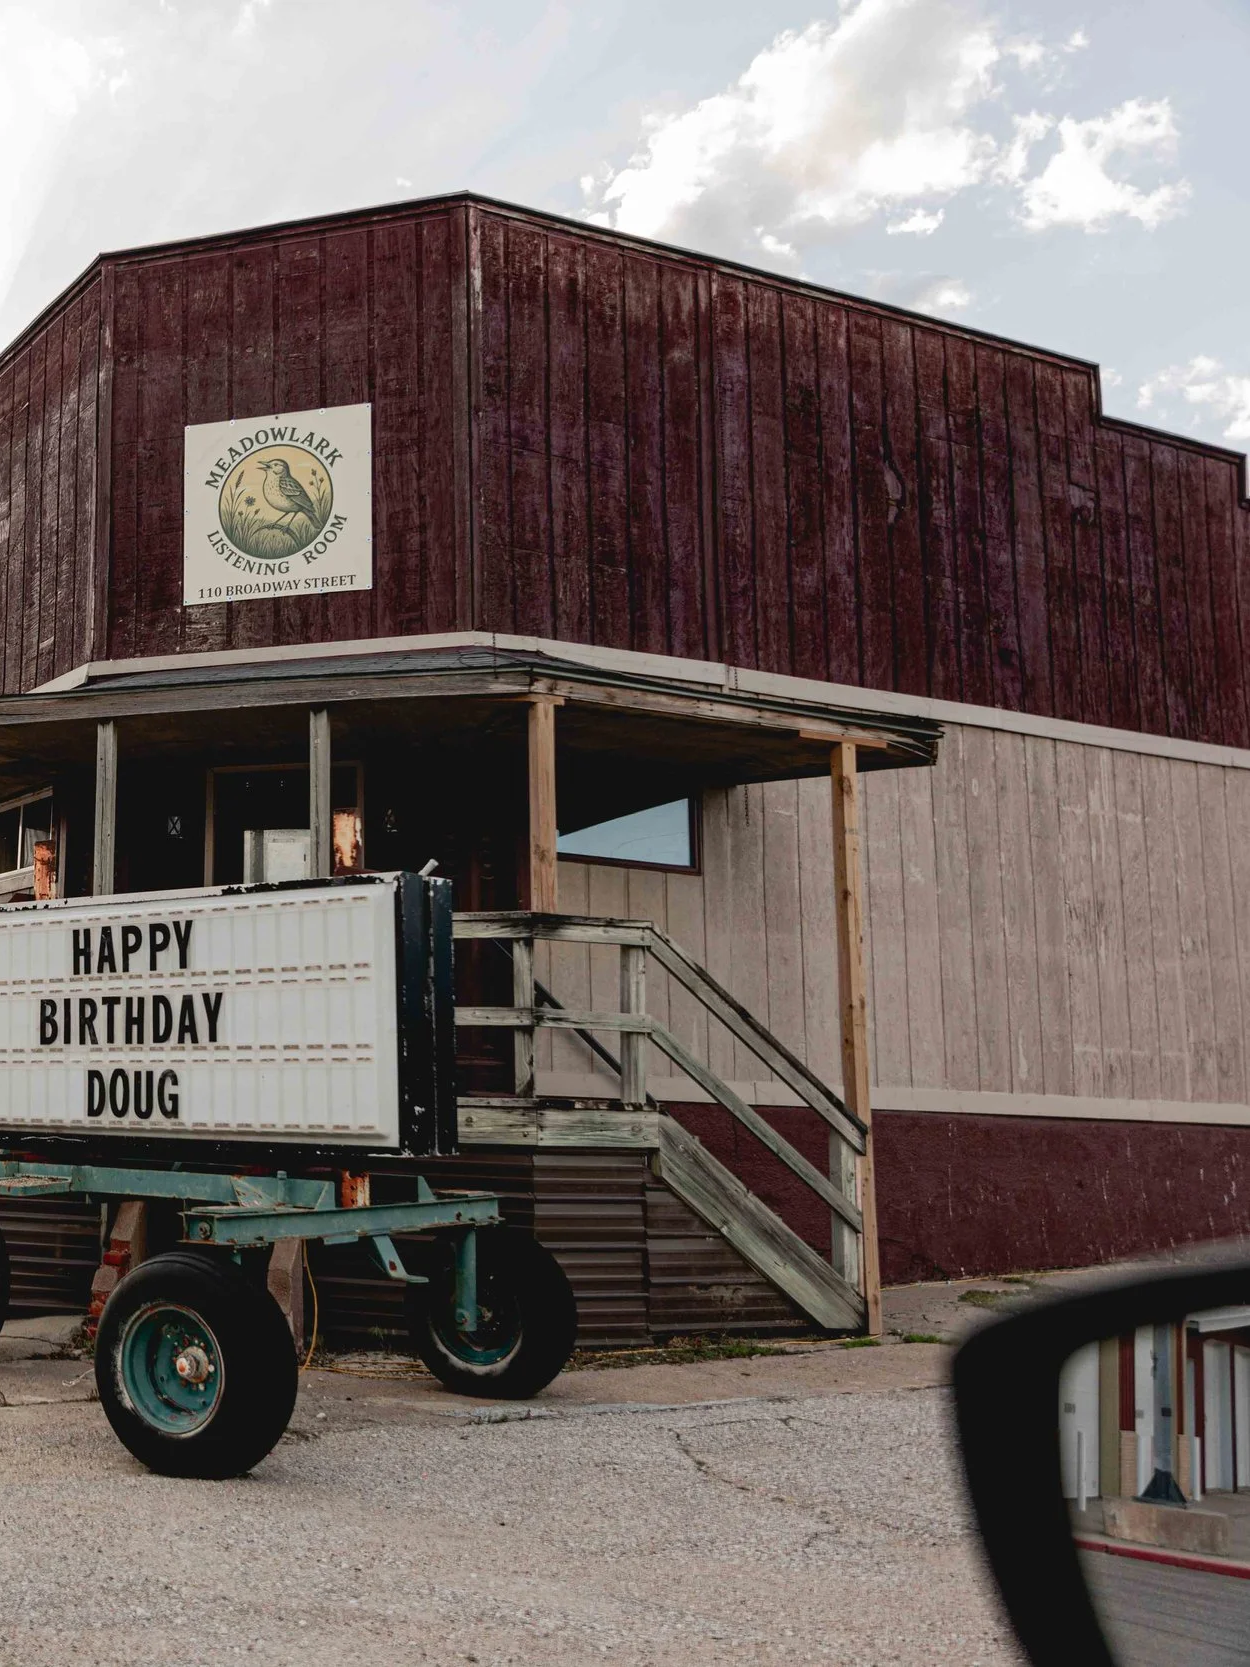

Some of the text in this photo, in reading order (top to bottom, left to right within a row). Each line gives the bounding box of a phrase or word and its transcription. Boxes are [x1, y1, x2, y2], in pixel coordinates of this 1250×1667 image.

[204, 426, 343, 490] MEADOWLARK
[207, 513, 347, 576] LISTENING ROOM
[198, 574, 357, 599] 110 BROADWAY STREET
[71, 919, 194, 976] HAPPY
[38, 991, 223, 1046] BIRTHDAY
[86, 1067, 180, 1120] DOUG
